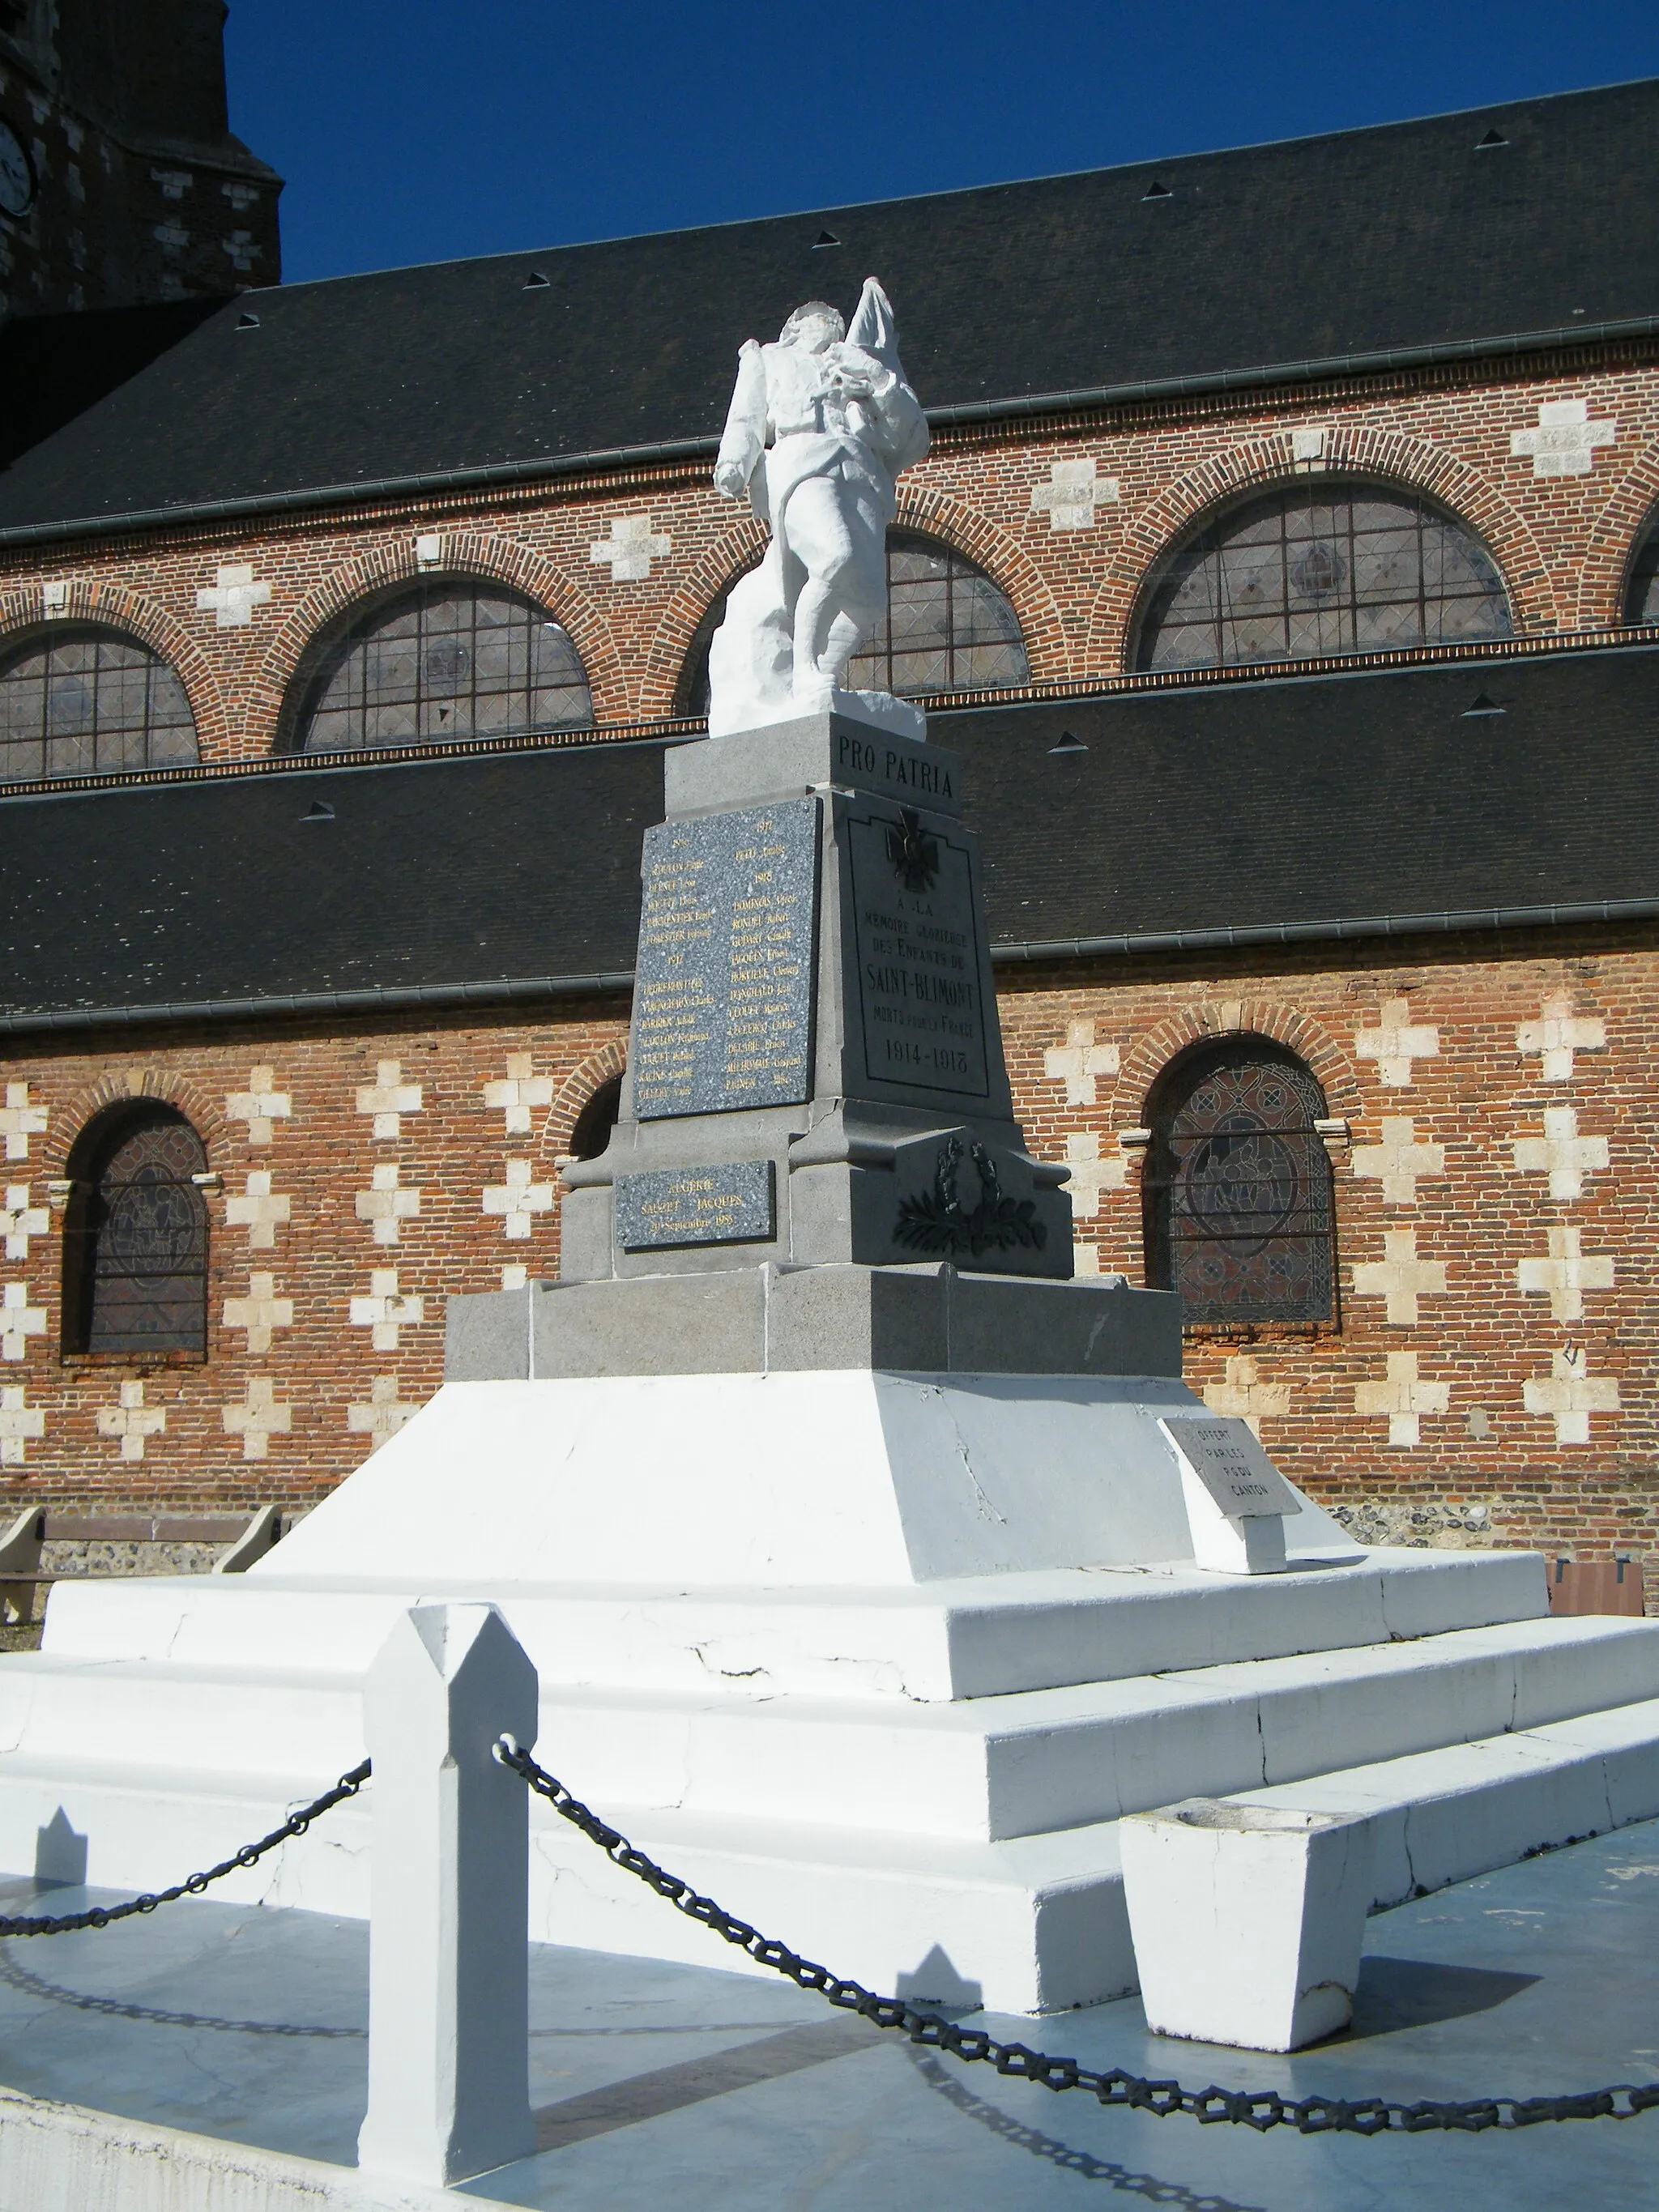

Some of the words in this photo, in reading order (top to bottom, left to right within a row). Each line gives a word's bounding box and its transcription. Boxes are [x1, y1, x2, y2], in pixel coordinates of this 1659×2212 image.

[838, 735, 876, 773] PRO
[886, 752, 953, 798] PATRIA
[917, 926, 968, 948] GLORIEUSE
[873, 938, 892, 954] DES
[952, 954, 965, 970] DE
[867, 963, 975, 1010] SAINT-BLIMONT
[873, 1005, 904, 1025] MORTS
[886, 1039, 967, 1073] 1914-1918
[696, 1195, 742, 1213] JACQUES
[664, 1217, 709, 1232] Septembre
[1196, 1430, 1231, 1441] OFFERT
[1205, 1448, 1226, 1460] PAR
[1227, 1448, 1245, 1460] LES
[1231, 1485, 1269, 1497] CANTON
